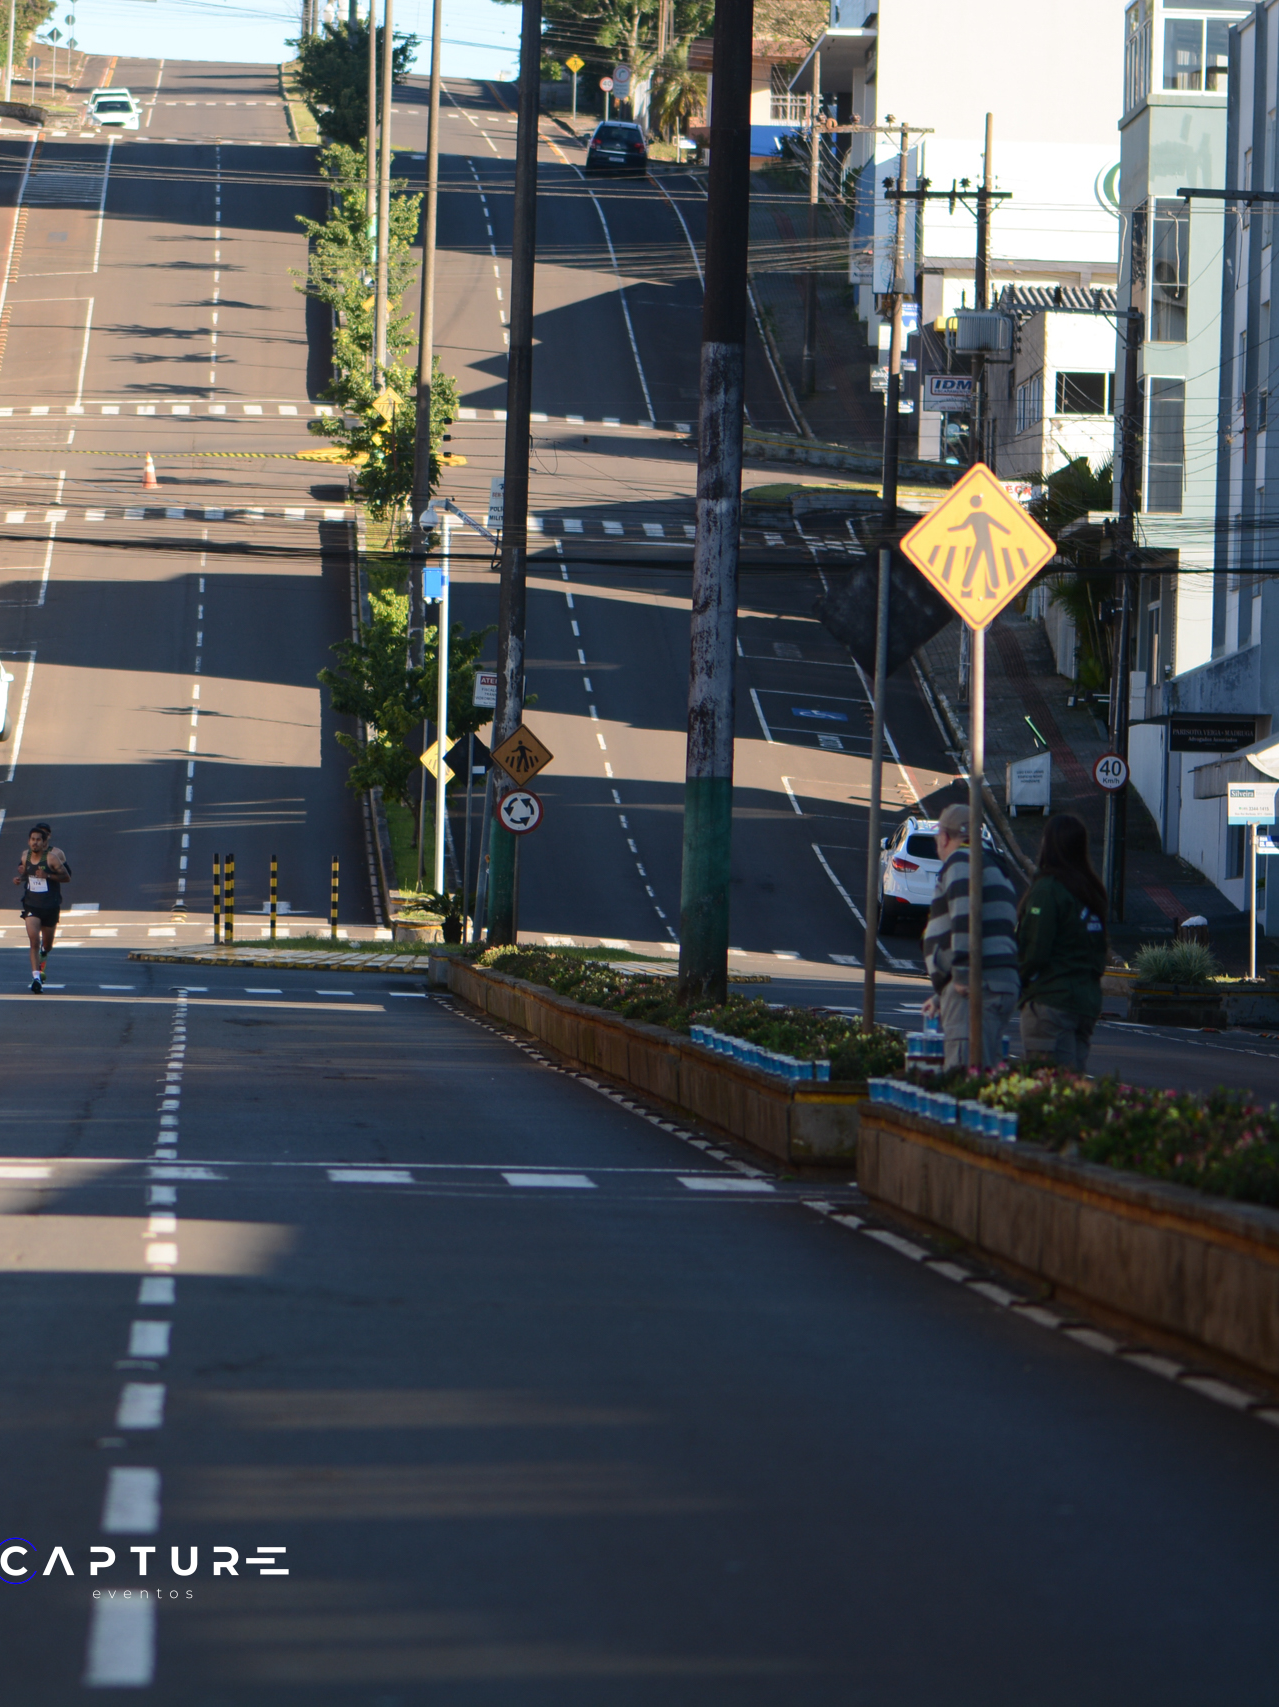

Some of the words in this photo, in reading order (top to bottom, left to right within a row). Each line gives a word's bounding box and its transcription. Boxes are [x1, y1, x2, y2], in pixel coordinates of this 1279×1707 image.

[1099, 760, 1121, 777] 40
[1101, 777, 1120, 785] Km/h
[1231, 789, 1254, 797] Silveira
